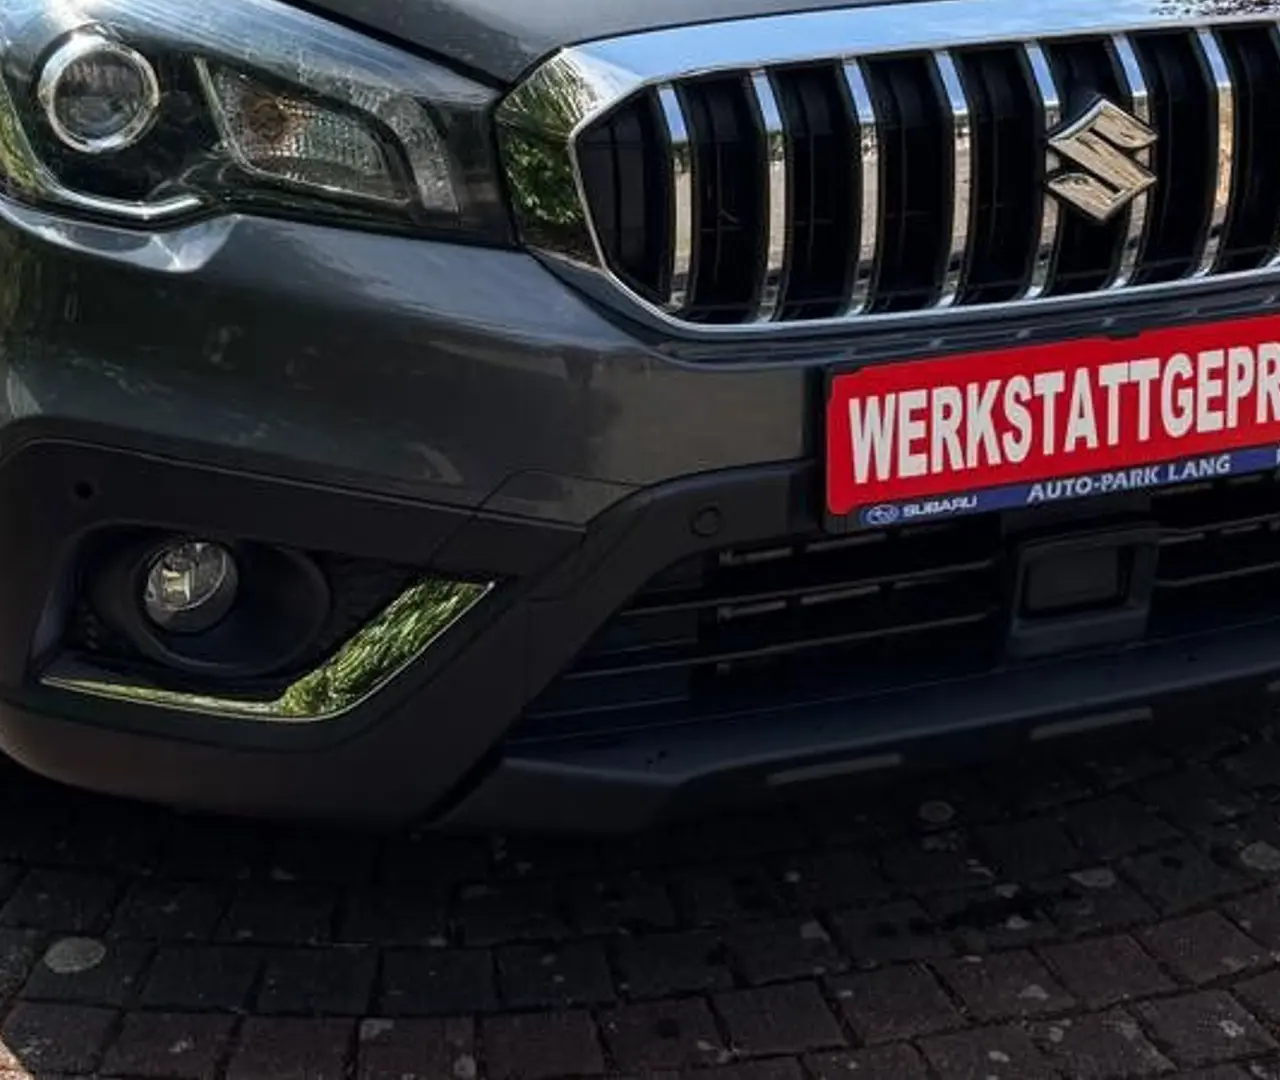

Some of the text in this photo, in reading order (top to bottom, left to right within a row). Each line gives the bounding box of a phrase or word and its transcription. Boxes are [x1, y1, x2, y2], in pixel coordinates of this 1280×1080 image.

[902, 494, 978, 517] SUBARU
[1026, 465, 1161, 503] AUTO-PARK
[1167, 454, 1231, 482] LANG
